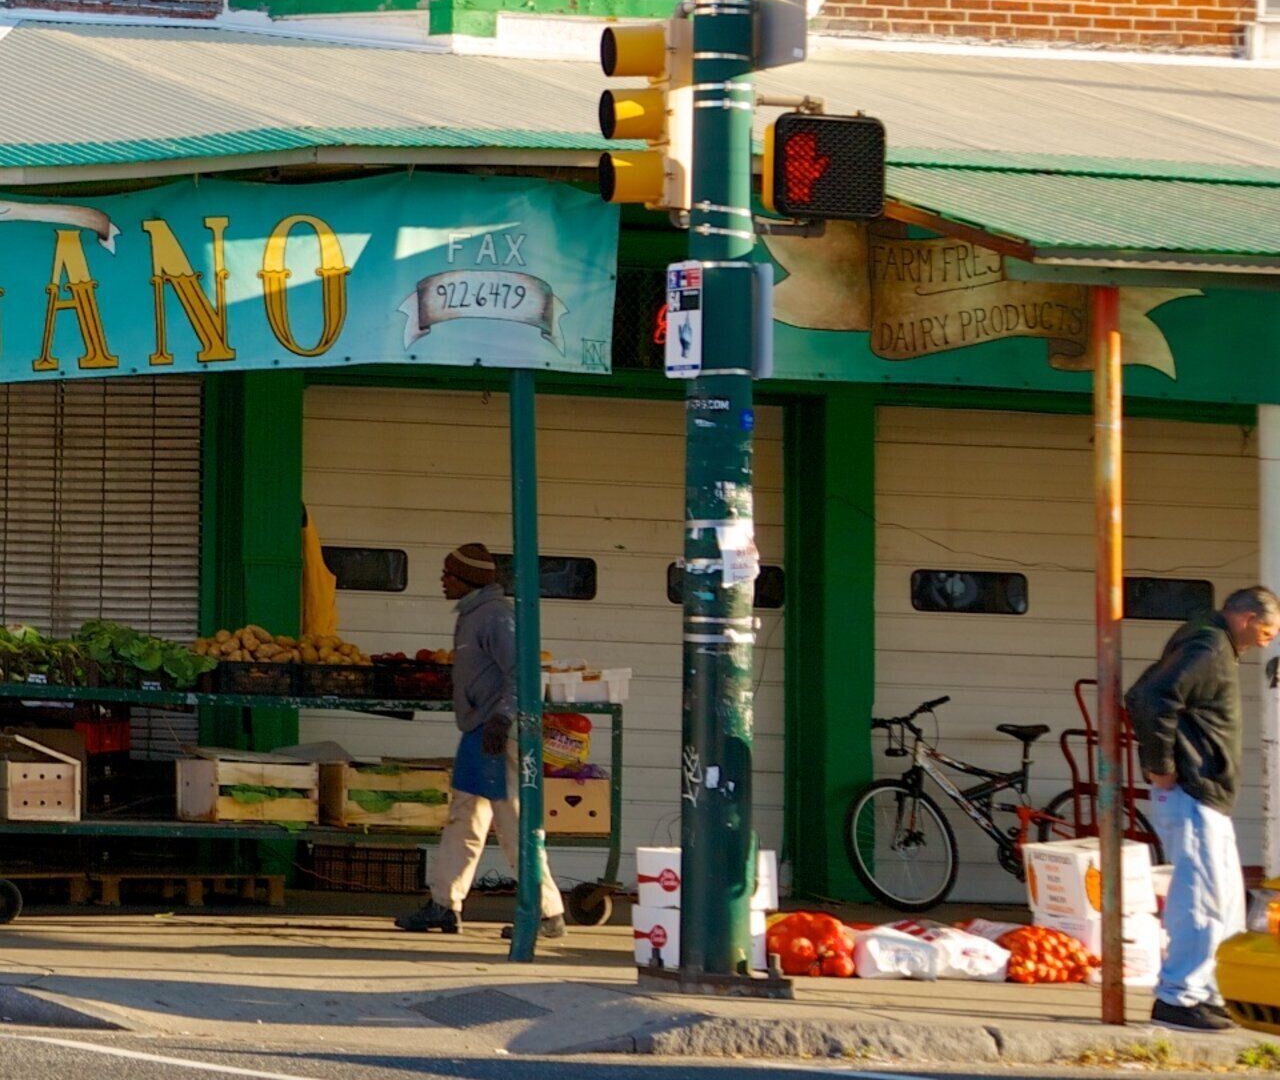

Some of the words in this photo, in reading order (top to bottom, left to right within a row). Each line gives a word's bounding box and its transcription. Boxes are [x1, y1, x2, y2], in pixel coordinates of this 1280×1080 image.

[447, 232, 526, 266] FAX
[870, 244, 933, 283] FARM
[436, 281, 527, 313] 922-6479
[879, 314, 950, 352] DAIRY
[959, 301, 1081, 341] PRODUCTS
